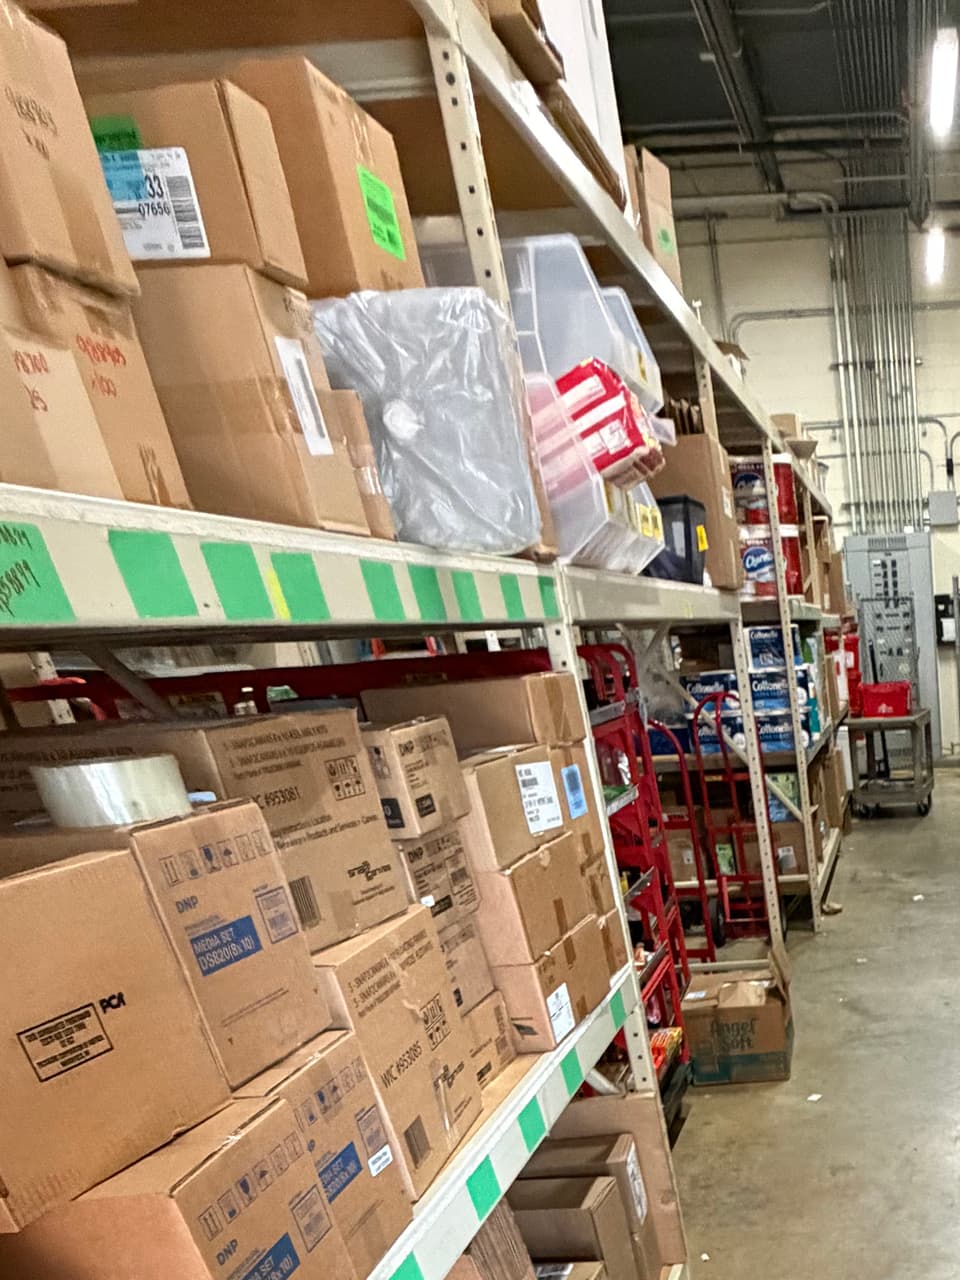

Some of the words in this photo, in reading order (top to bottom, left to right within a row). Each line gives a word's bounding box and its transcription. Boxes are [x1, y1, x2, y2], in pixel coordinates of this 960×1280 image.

[759, 722, 792, 734] ottonelle
[176, 895, 199, 914] DNP
[193, 935, 221, 954] MEDIA
[220, 927, 235, 944] SET
[99, 991, 126, 1014] PCA
[216, 1239, 239, 1265] DNP
[260, 1255, 275, 1276] SET
